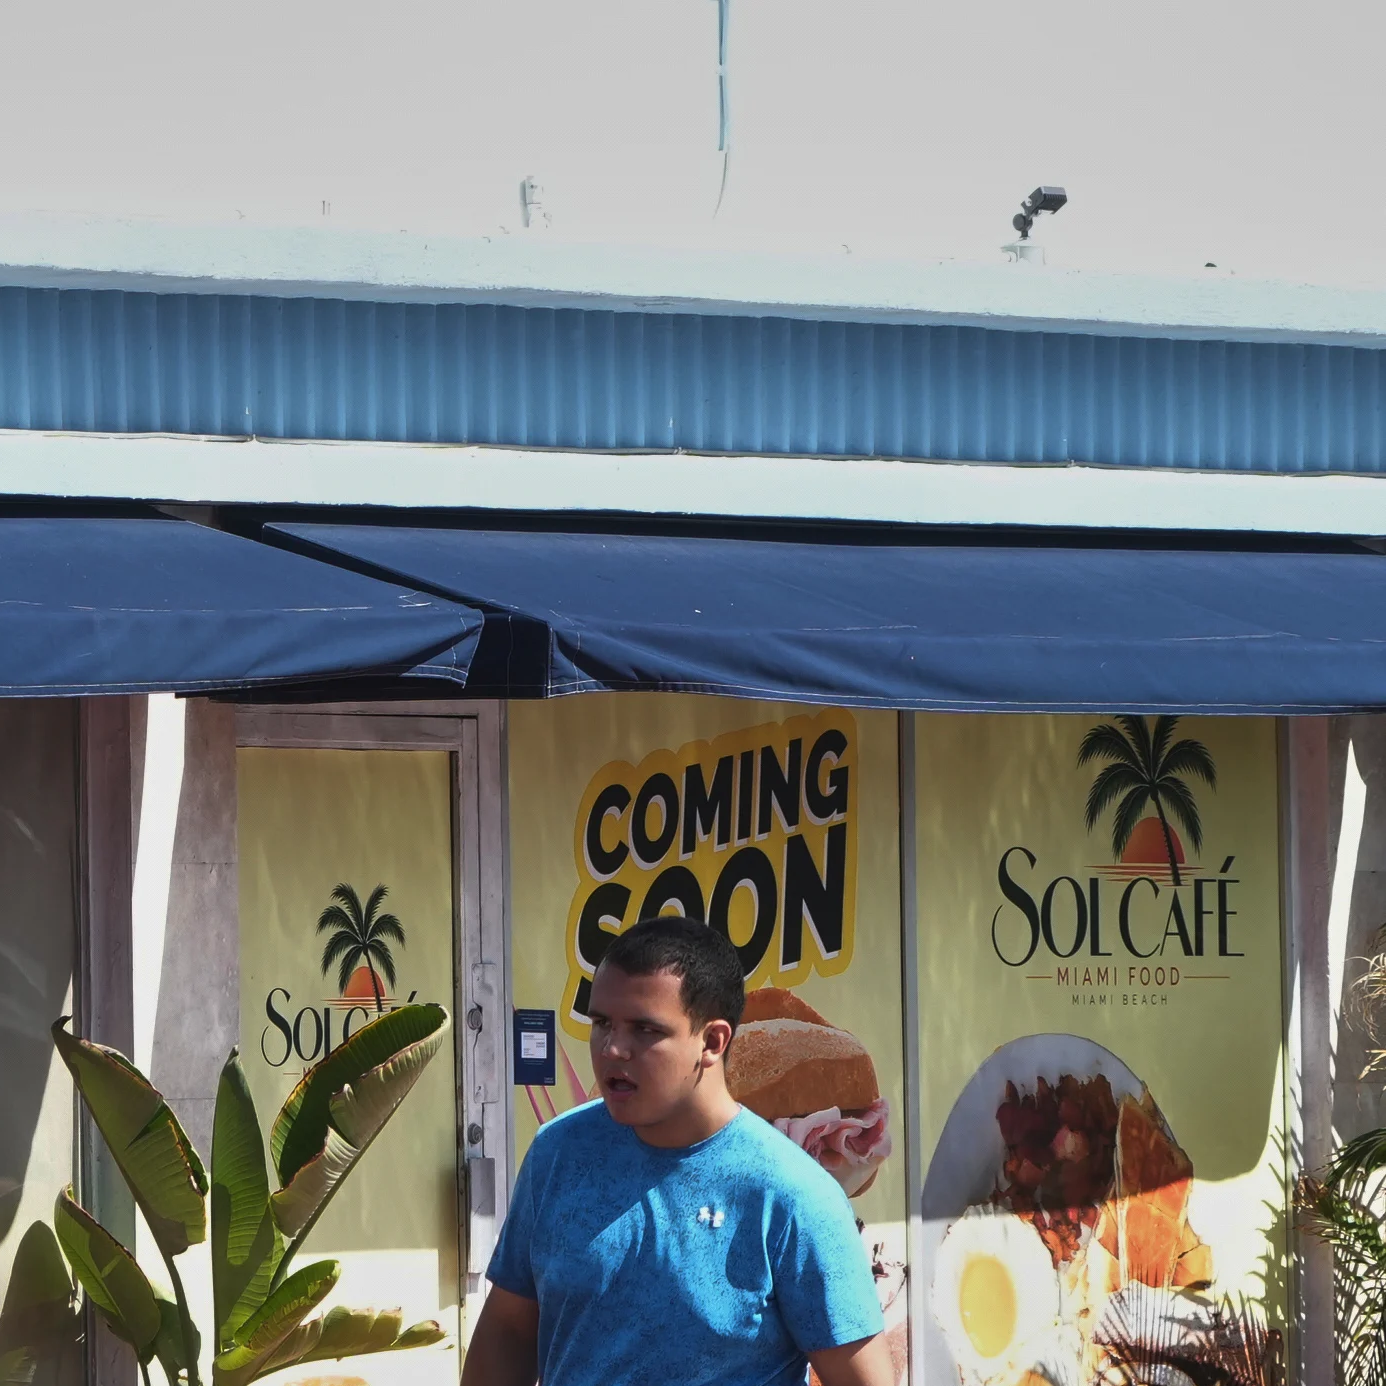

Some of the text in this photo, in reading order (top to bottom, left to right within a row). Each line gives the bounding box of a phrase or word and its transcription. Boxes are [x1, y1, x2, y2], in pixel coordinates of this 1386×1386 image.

[585, 729, 849, 876] COMING
[992, 847, 1244, 967] SOL CAFÉ
[1057, 966, 1180, 986] MIAMI FOOD
[1071, 993, 1169, 1006] MIAMI BEACH
